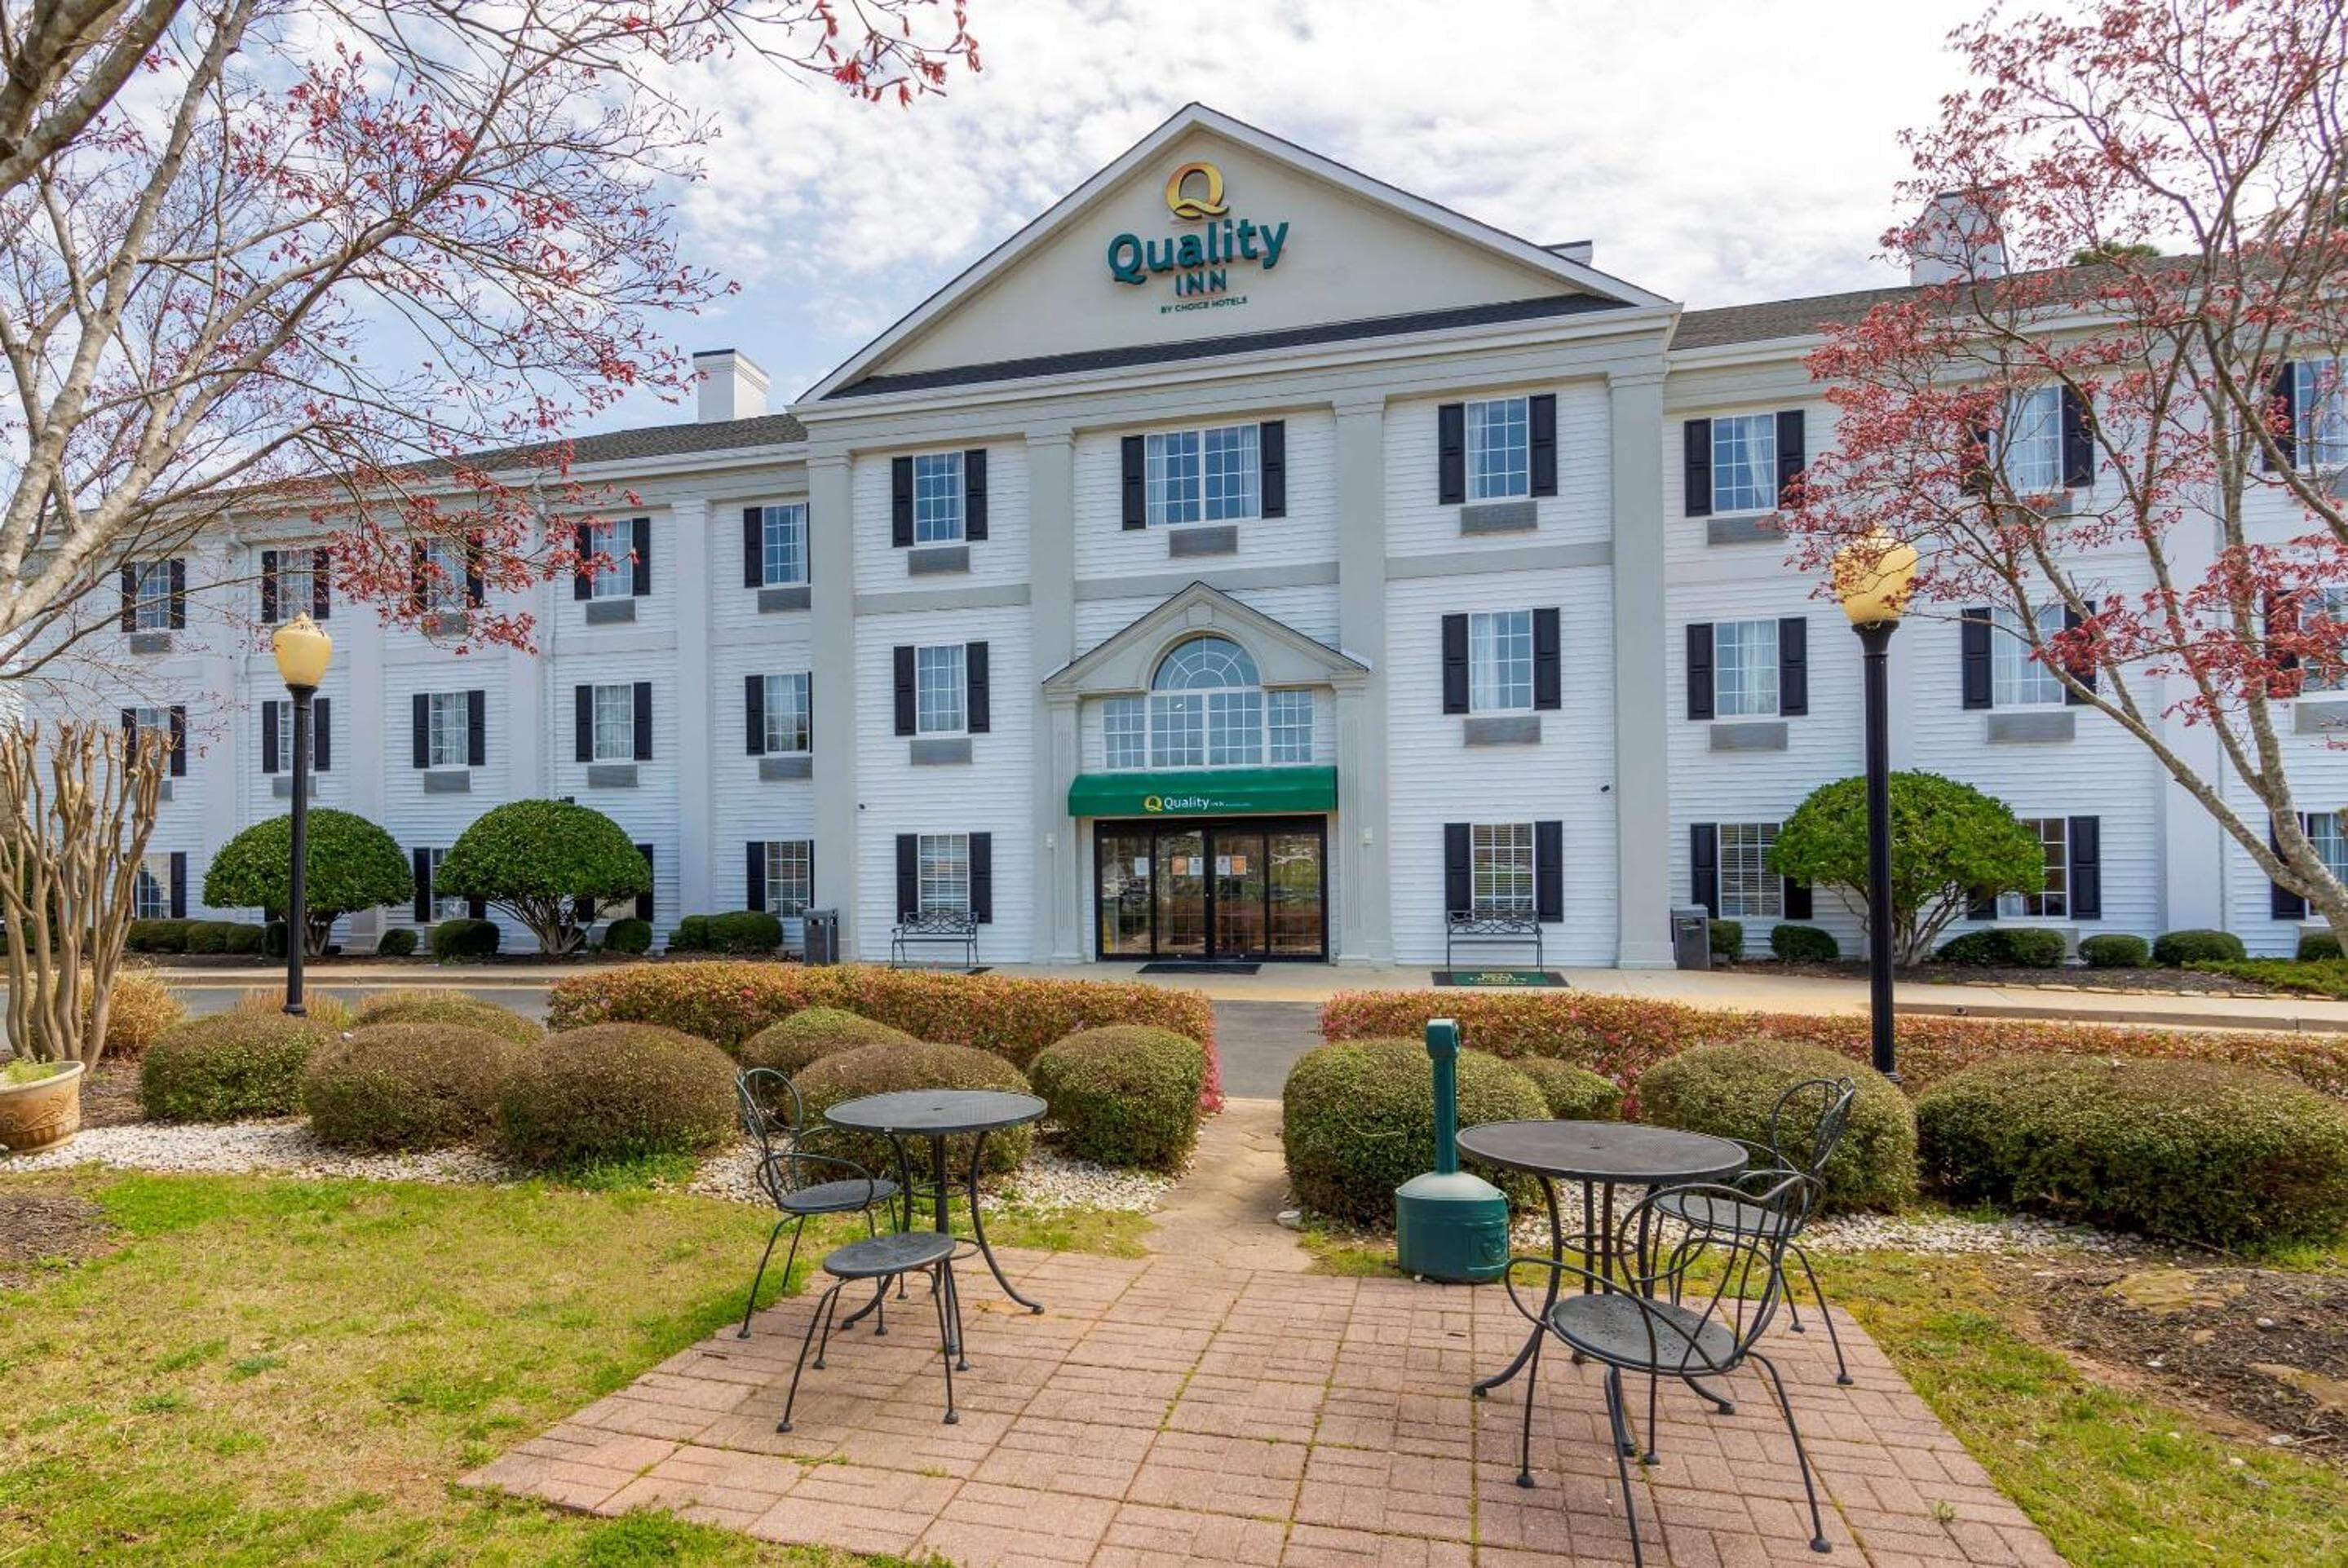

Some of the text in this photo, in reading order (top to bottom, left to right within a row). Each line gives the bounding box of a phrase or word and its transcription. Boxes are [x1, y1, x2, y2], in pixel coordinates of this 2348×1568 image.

[1165, 161, 1230, 220] Q
[1108, 219, 1289, 285] Quality
[1175, 268, 1227, 296] INN
[1161, 295, 1248, 314] BY CHOICE HOTELS
[1164, 797, 1209, 811] Quality
